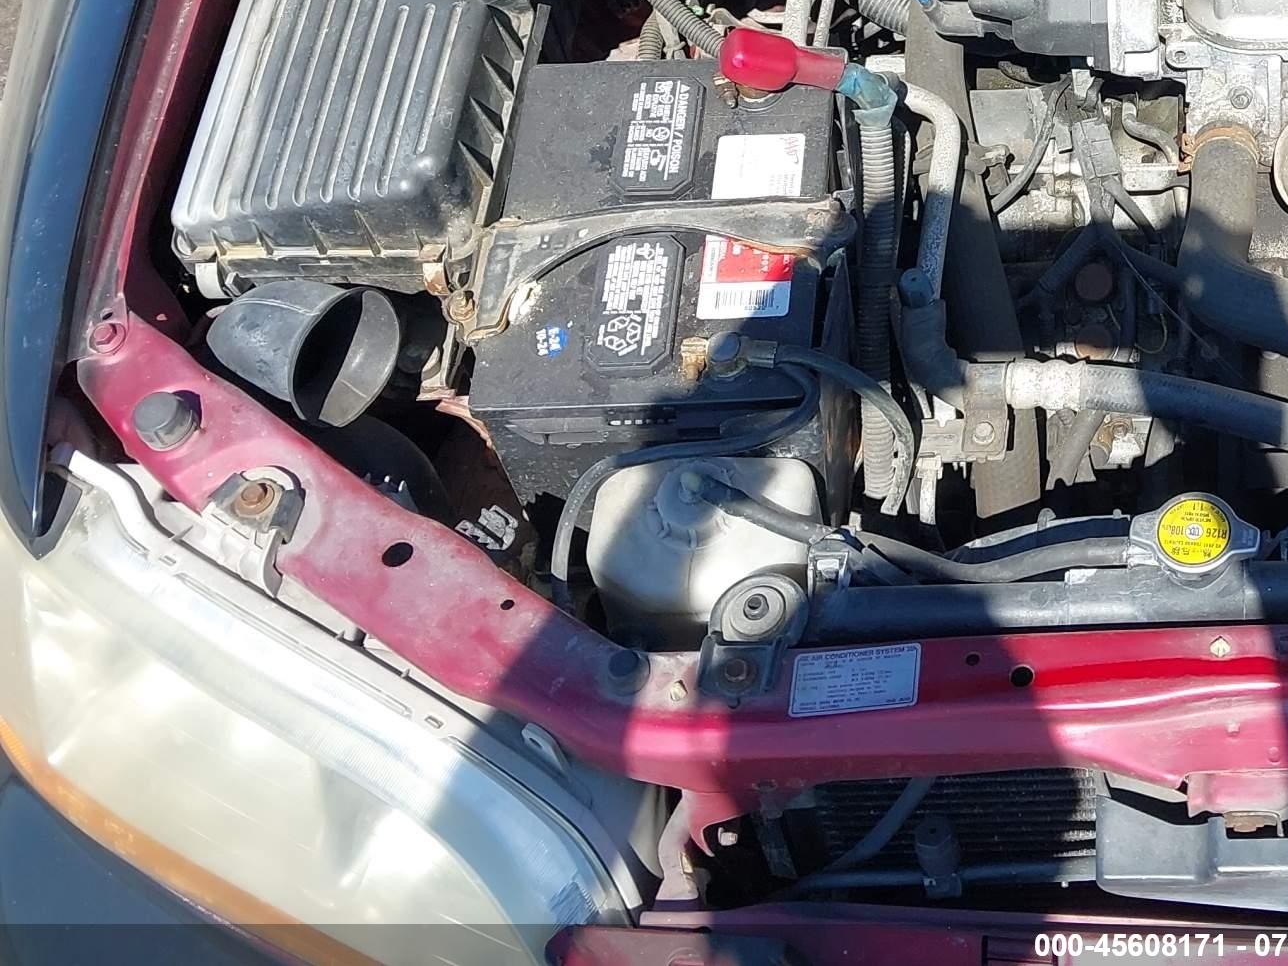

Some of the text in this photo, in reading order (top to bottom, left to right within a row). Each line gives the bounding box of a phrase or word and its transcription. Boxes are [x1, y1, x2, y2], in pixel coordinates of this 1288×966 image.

[673, 92, 690, 131] DANGER
[668, 139, 683, 174] POISON
[1206, 527, 1228, 540] R126
[811, 647, 905, 662] AIR CONDITIONER SYSTEM
